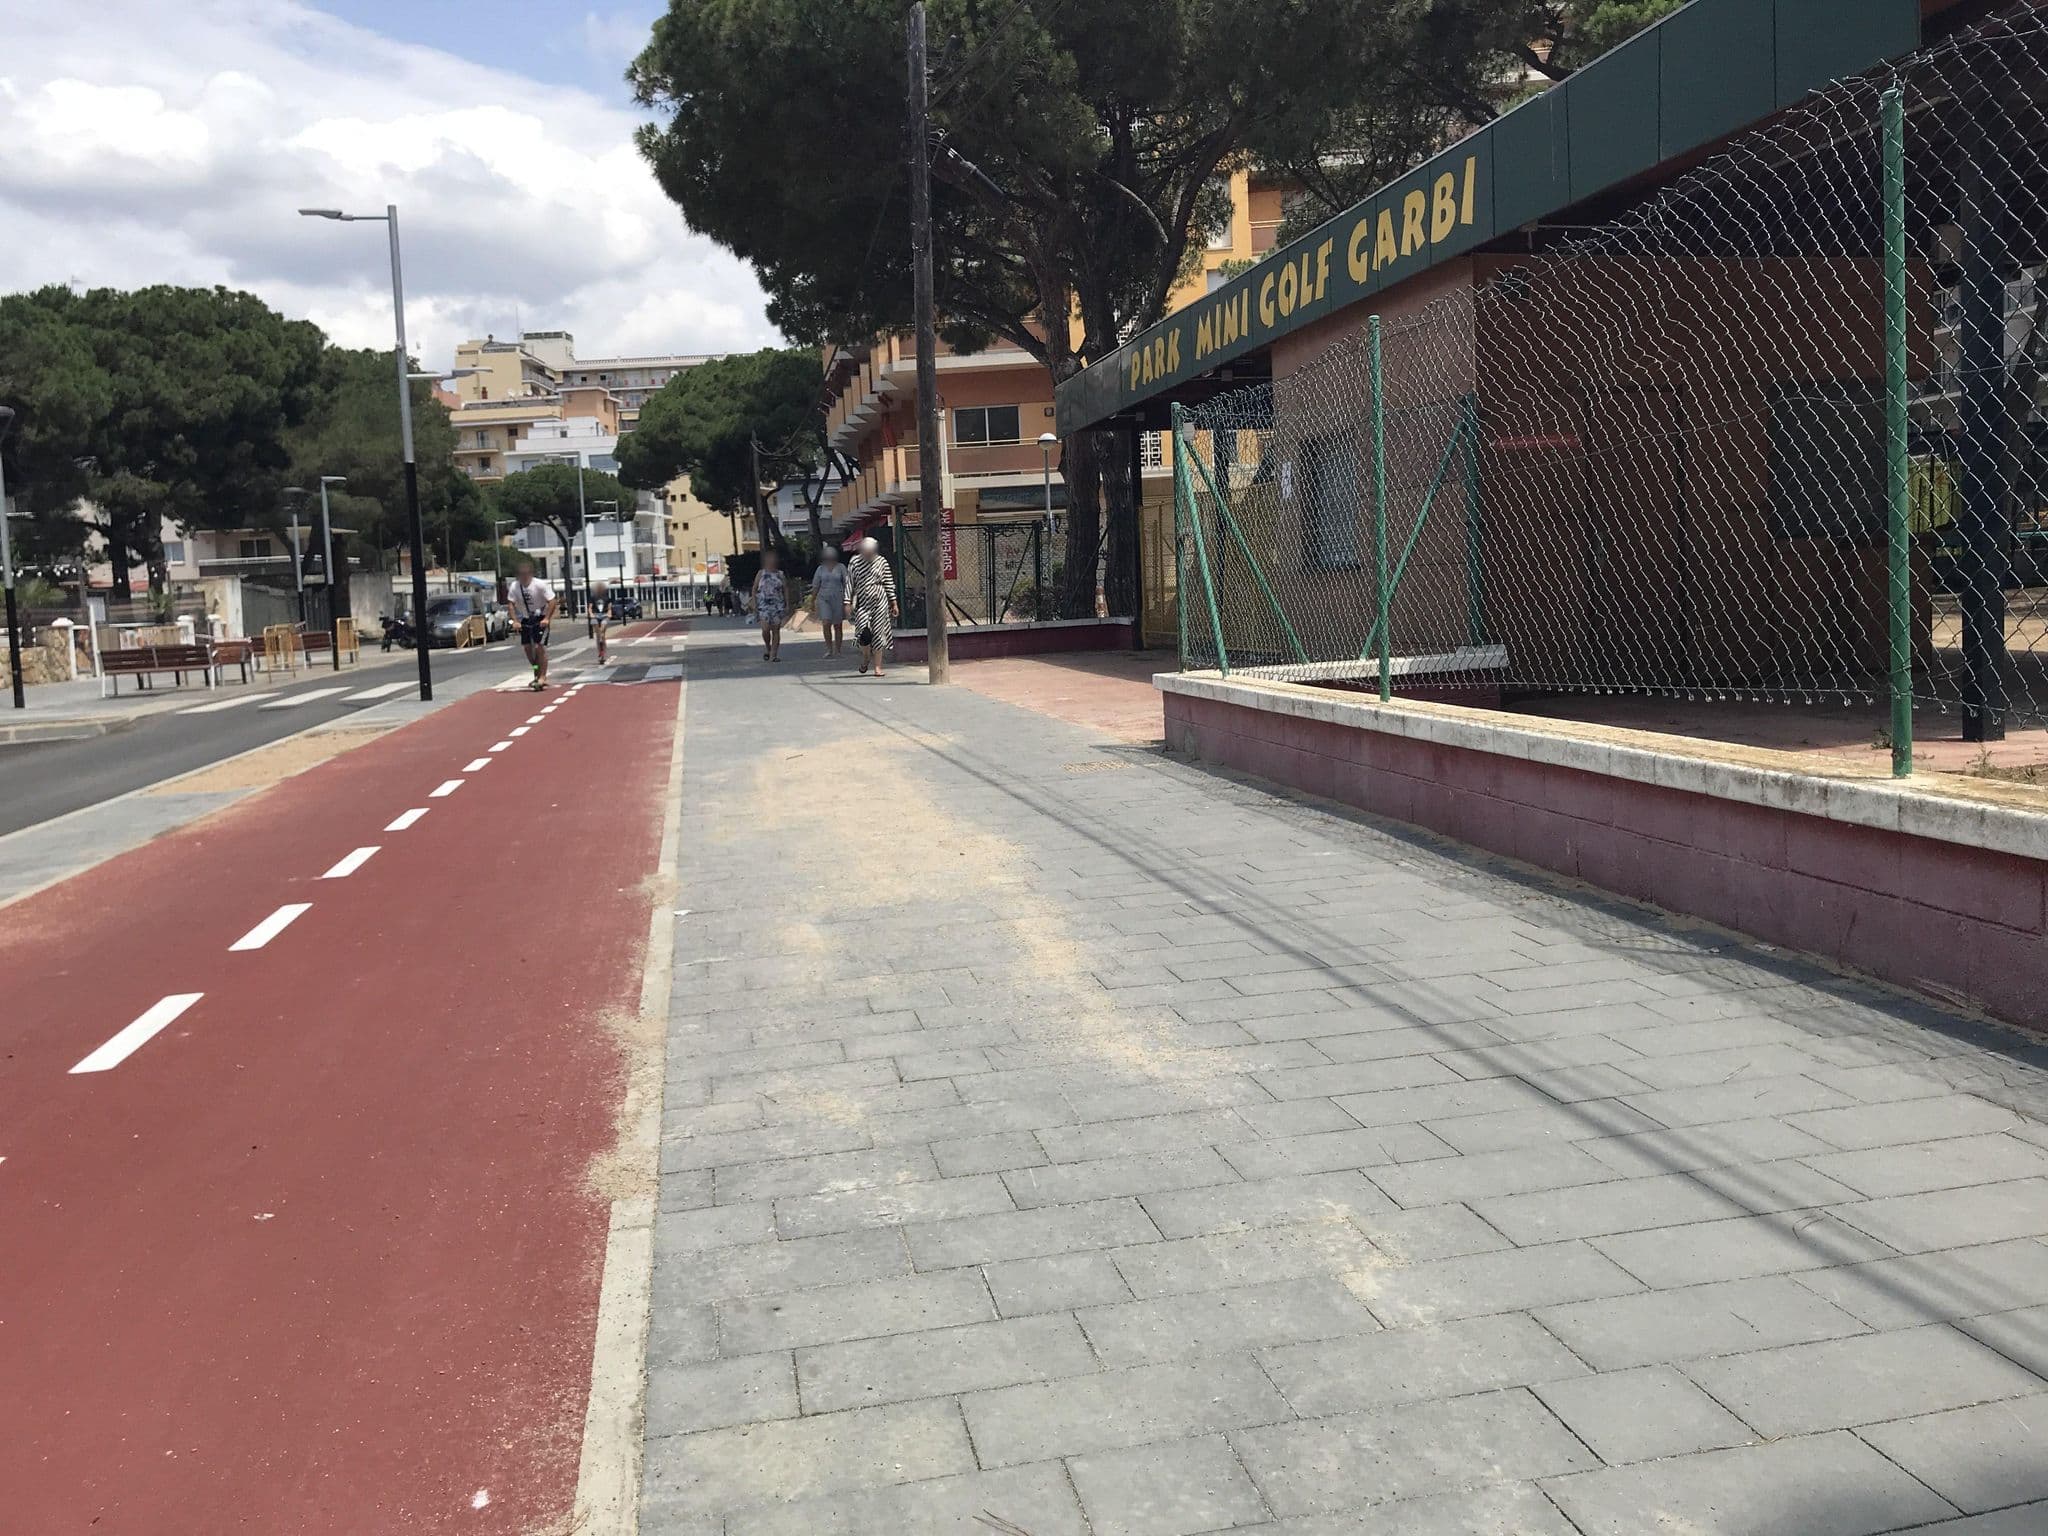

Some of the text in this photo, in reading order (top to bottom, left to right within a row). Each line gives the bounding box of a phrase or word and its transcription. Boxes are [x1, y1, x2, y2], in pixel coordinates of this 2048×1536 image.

[1130, 156, 1476, 391] PARK MINI GOLF GARBI
